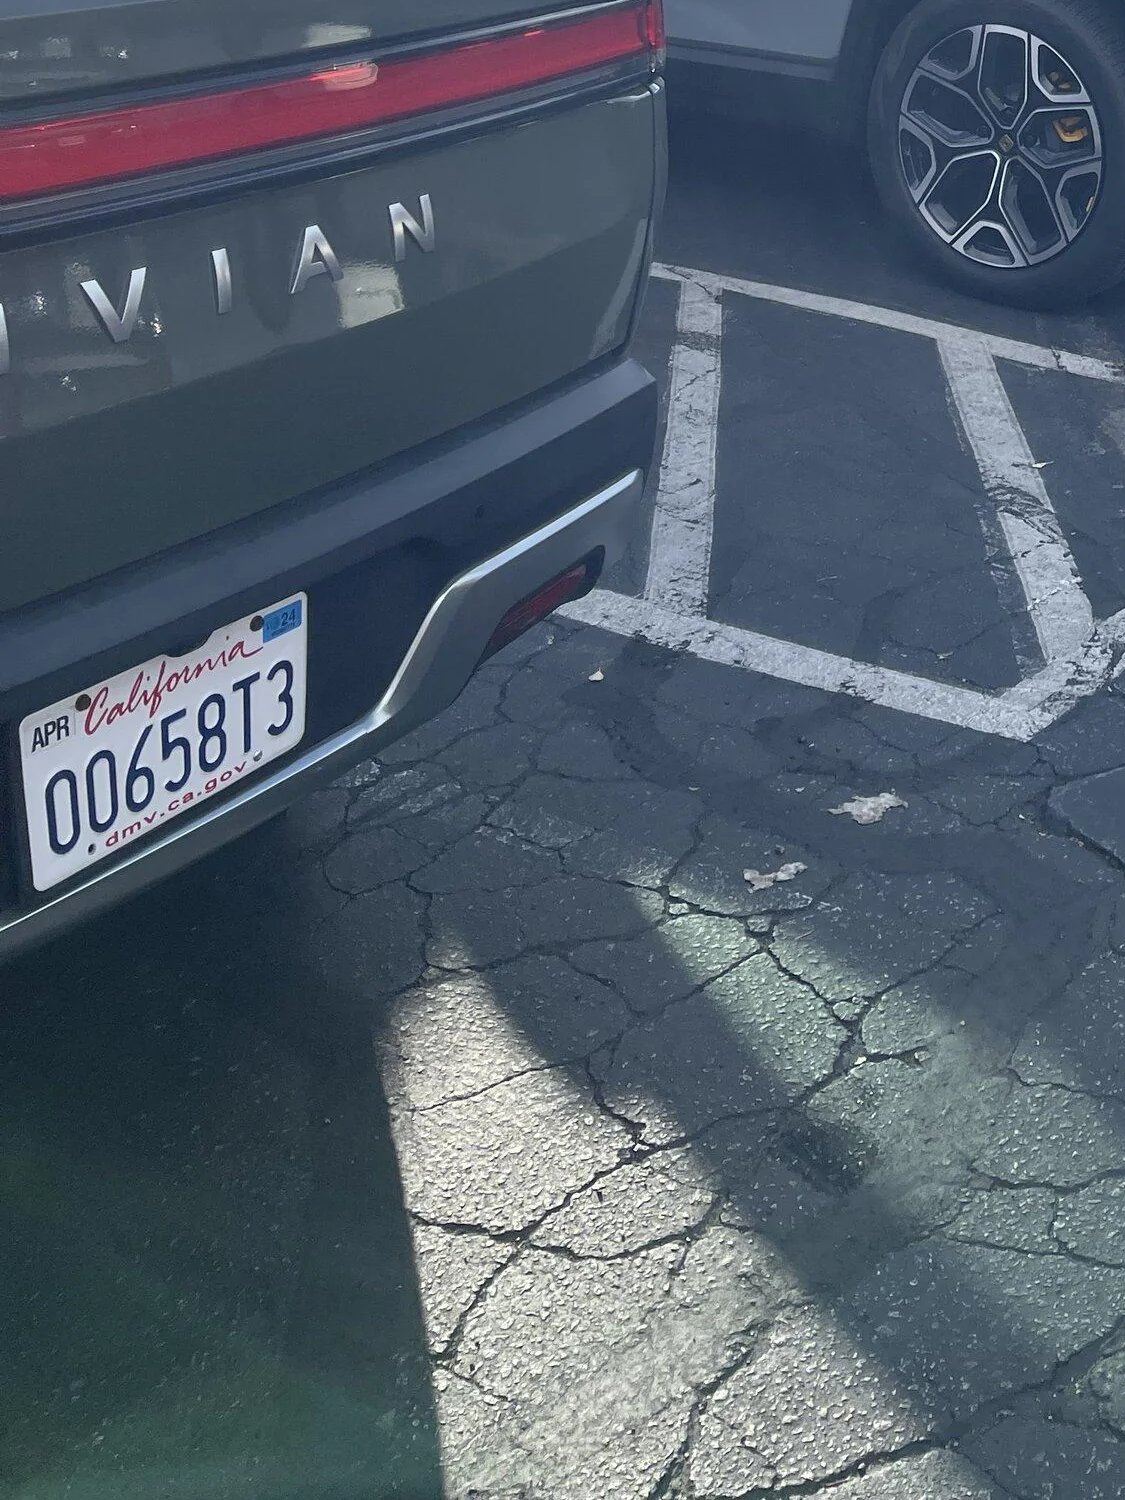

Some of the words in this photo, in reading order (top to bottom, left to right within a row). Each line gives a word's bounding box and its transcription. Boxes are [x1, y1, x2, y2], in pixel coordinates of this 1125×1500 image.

[281, 608, 296, 627] 24
[84, 635, 264, 736] California
[31, 714, 70, 753] APR
[44, 659, 294, 855] 00658T3
[105, 760, 248, 848] dmv.ca.gov
